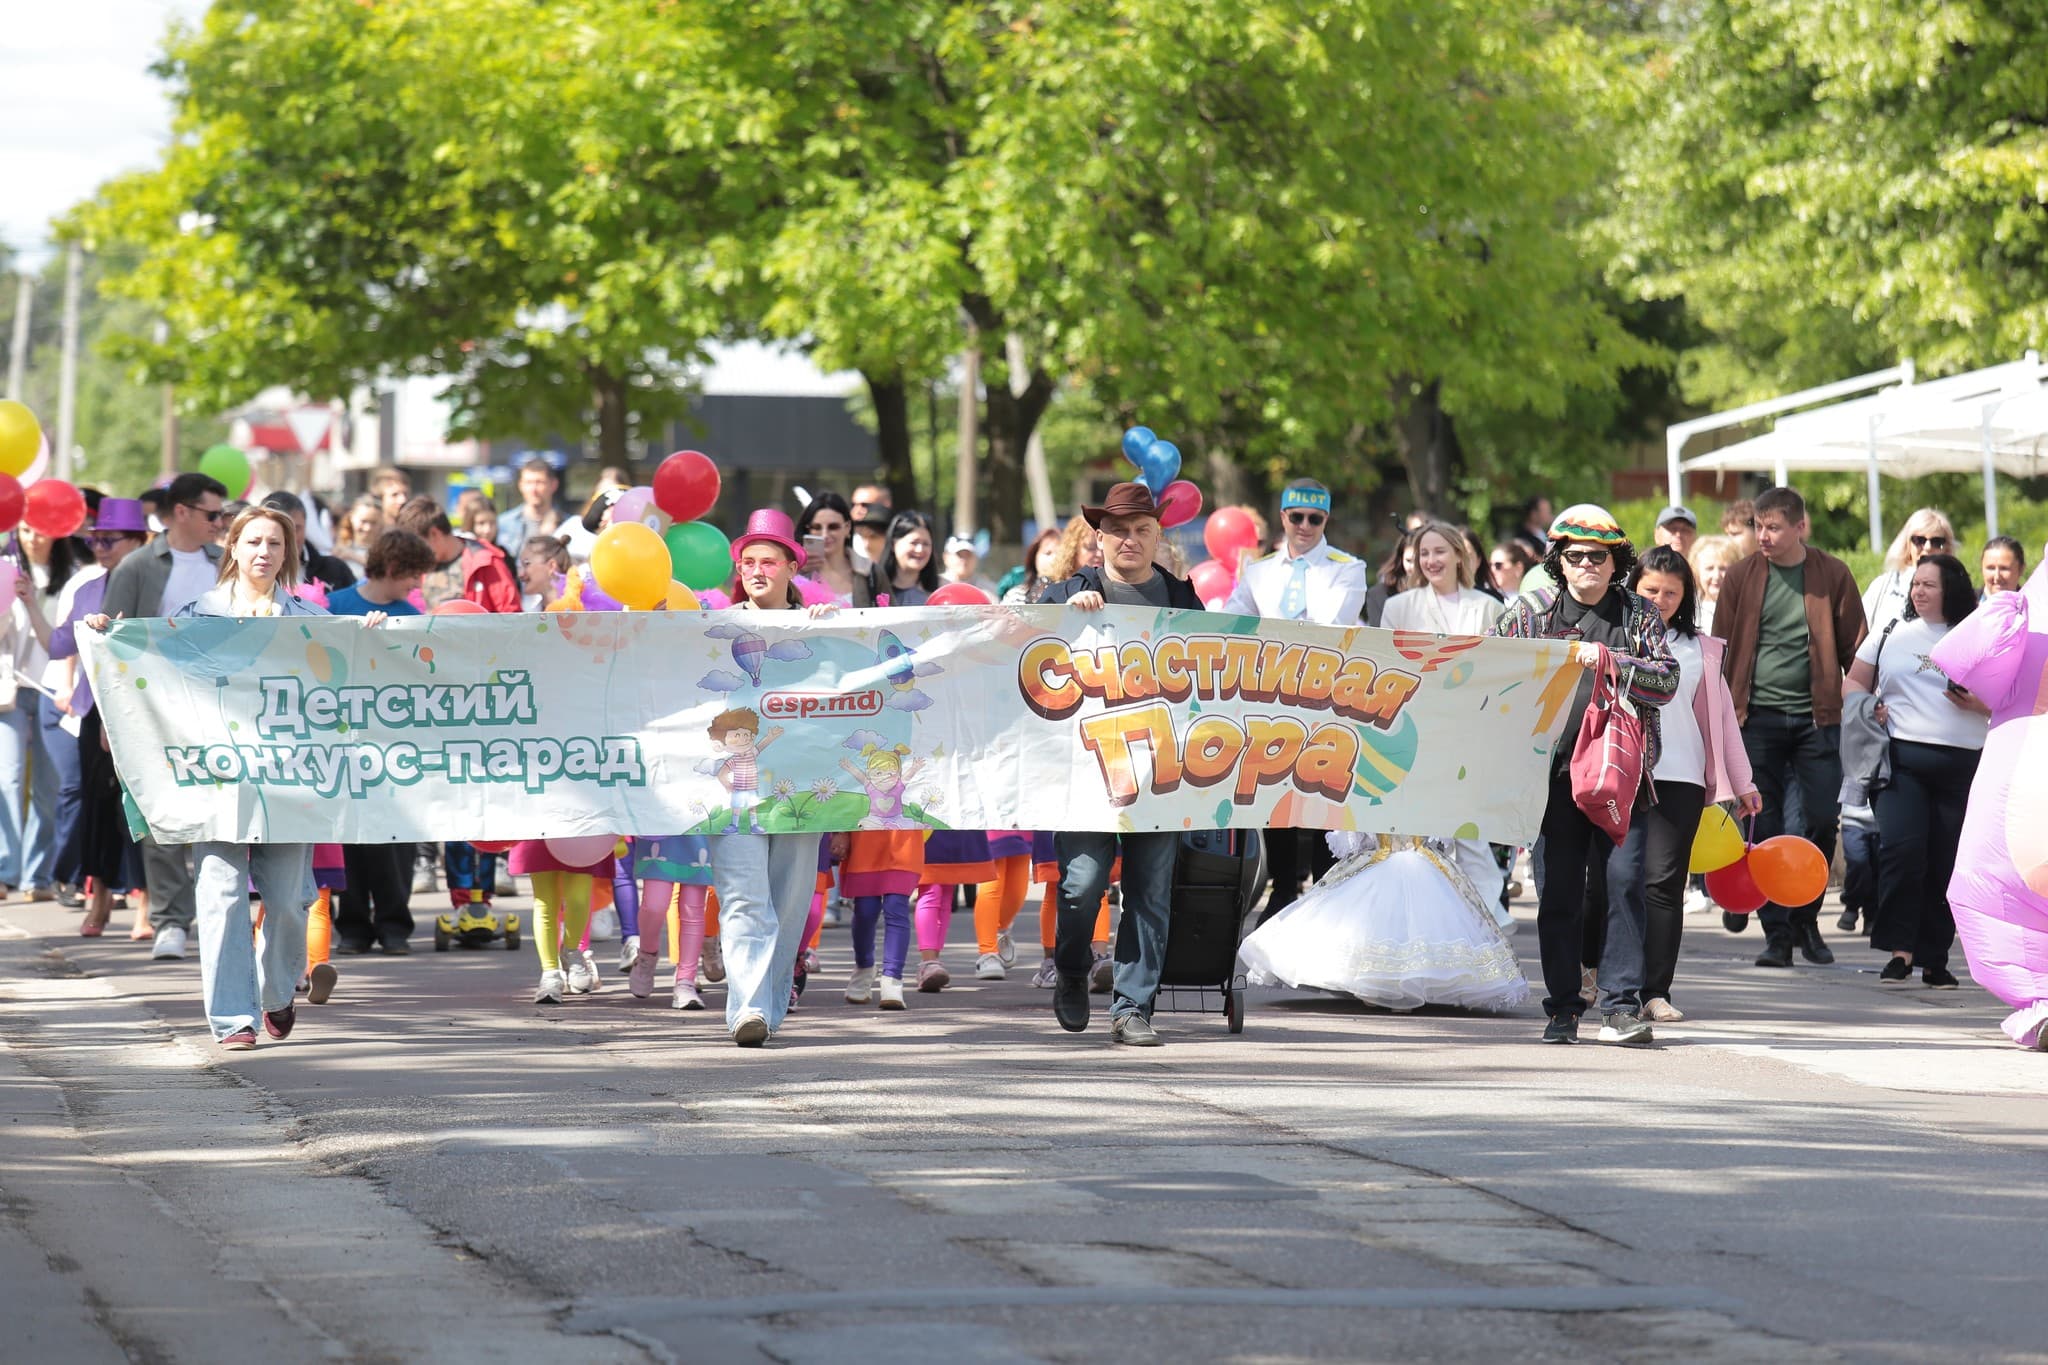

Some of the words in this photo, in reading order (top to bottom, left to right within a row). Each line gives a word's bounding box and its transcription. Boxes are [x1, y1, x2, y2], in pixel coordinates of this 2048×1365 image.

[1288, 490, 1326, 505] PILOT
[256, 670, 537, 738] Детский
[767, 690, 876, 718] esp.md
[1018, 636, 1421, 729] Счастливая
[165, 736, 645, 798] конкурс-парад
[1080, 702, 1358, 806] Пора
